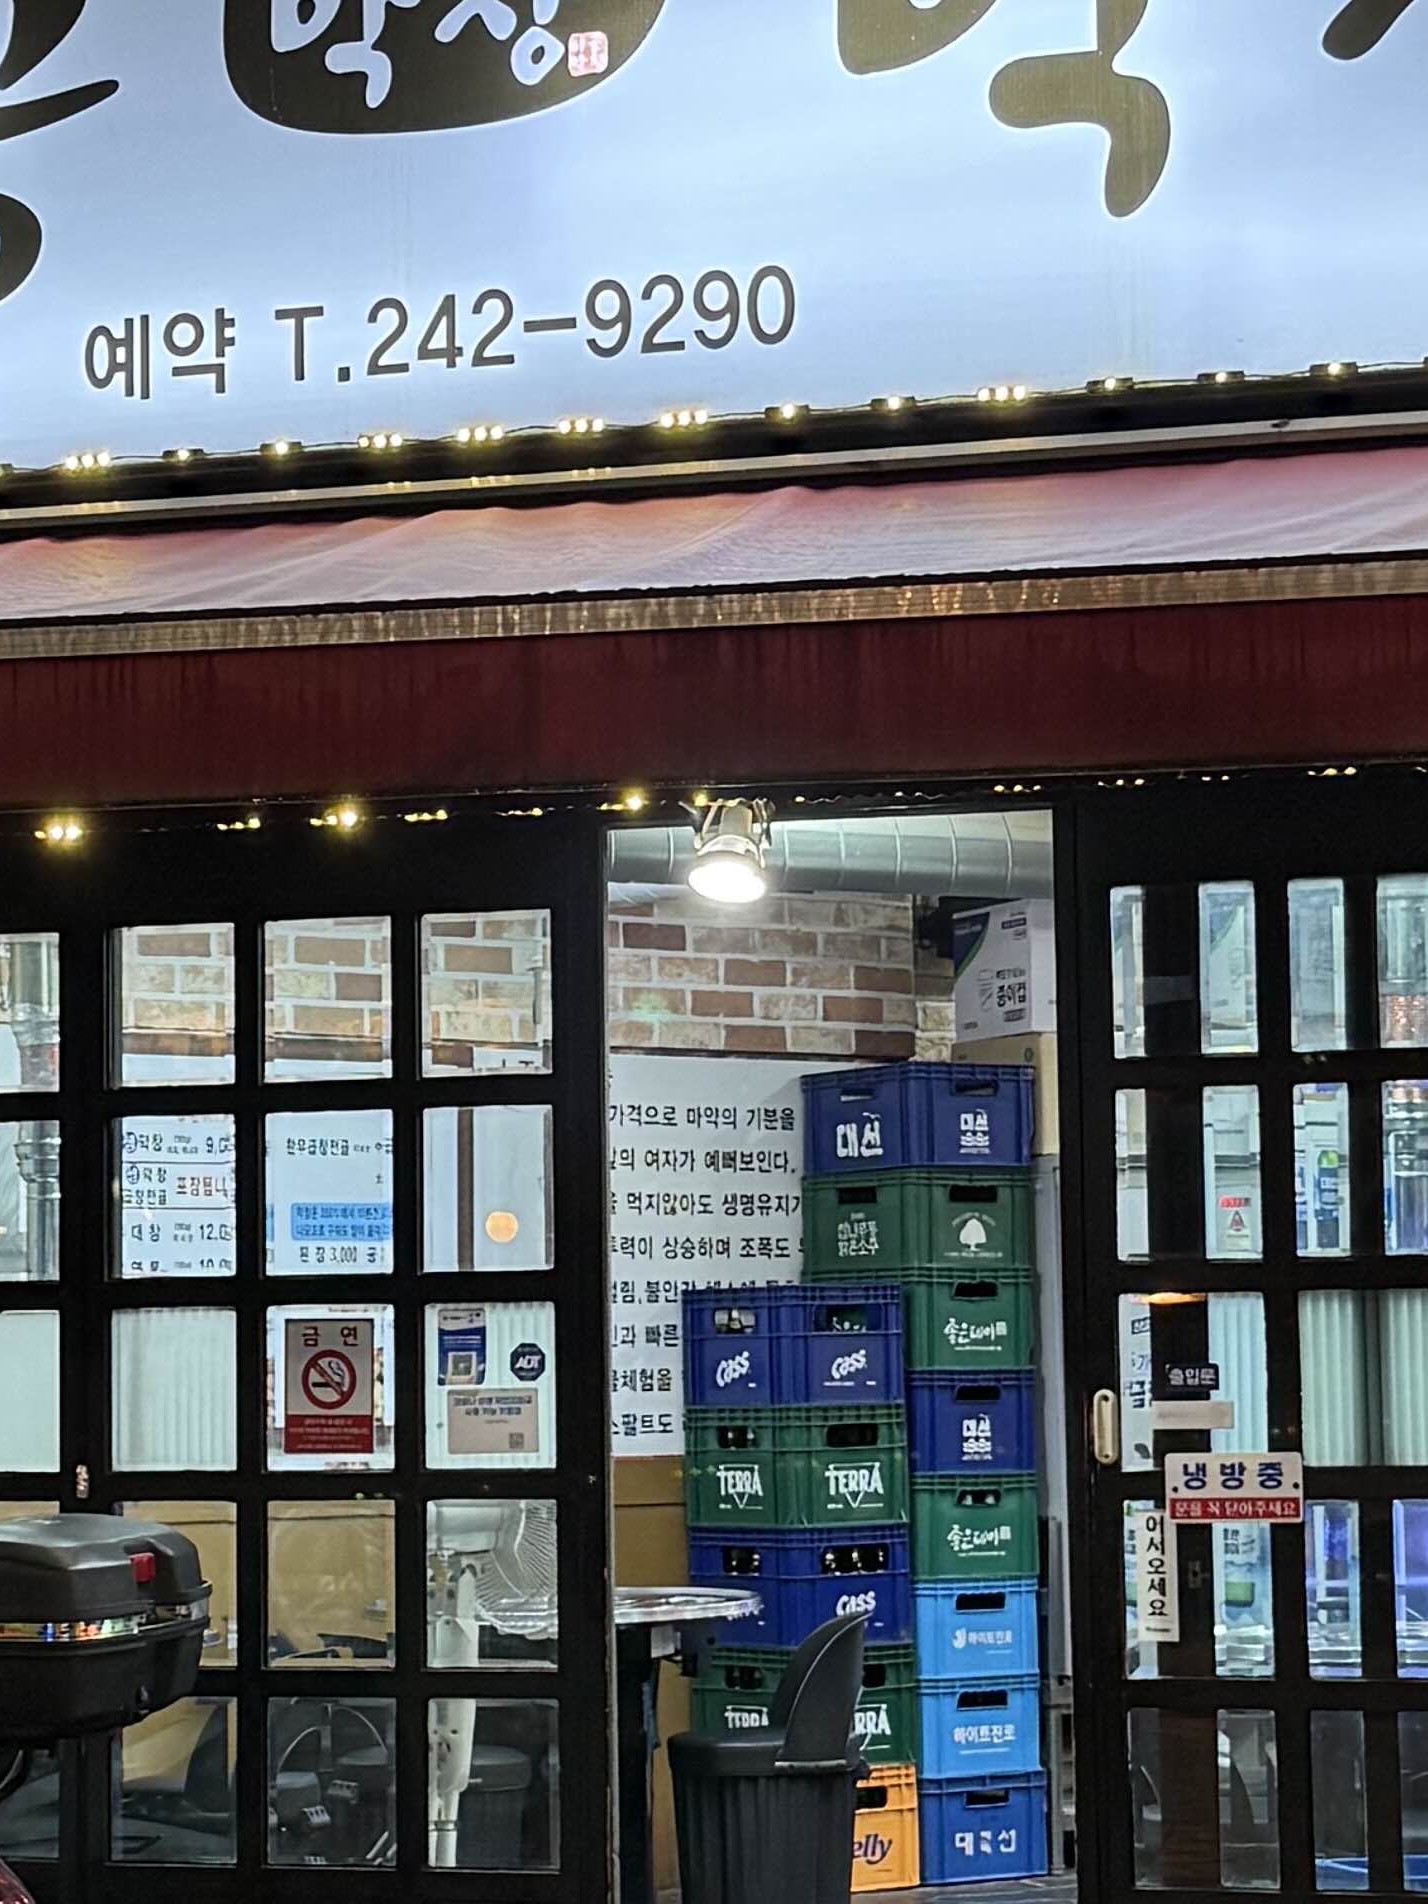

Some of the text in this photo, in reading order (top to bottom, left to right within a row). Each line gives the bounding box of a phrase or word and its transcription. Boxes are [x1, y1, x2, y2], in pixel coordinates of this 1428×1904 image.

[84, 313, 237, 402] 예약
[686, 1106, 737, 1129] 마약의
[746, 1107, 795, 1131] 기분을
[836, 1120, 883, 1158] 대선
[644, 1149, 695, 1172] 여자가
[739, 1237, 791, 1260] 조폭도
[301, 1325, 358, 1347] 금연
[515, 1355, 541, 1369] ADT
[717, 1464, 763, 1497] TERRA
[825, 1462, 884, 1496] TERRA
[1145, 1515, 1169, 1616] 어서오세요
[953, 1724, 1016, 1745] 하이트진로
[852, 1833, 893, 1865] elly
